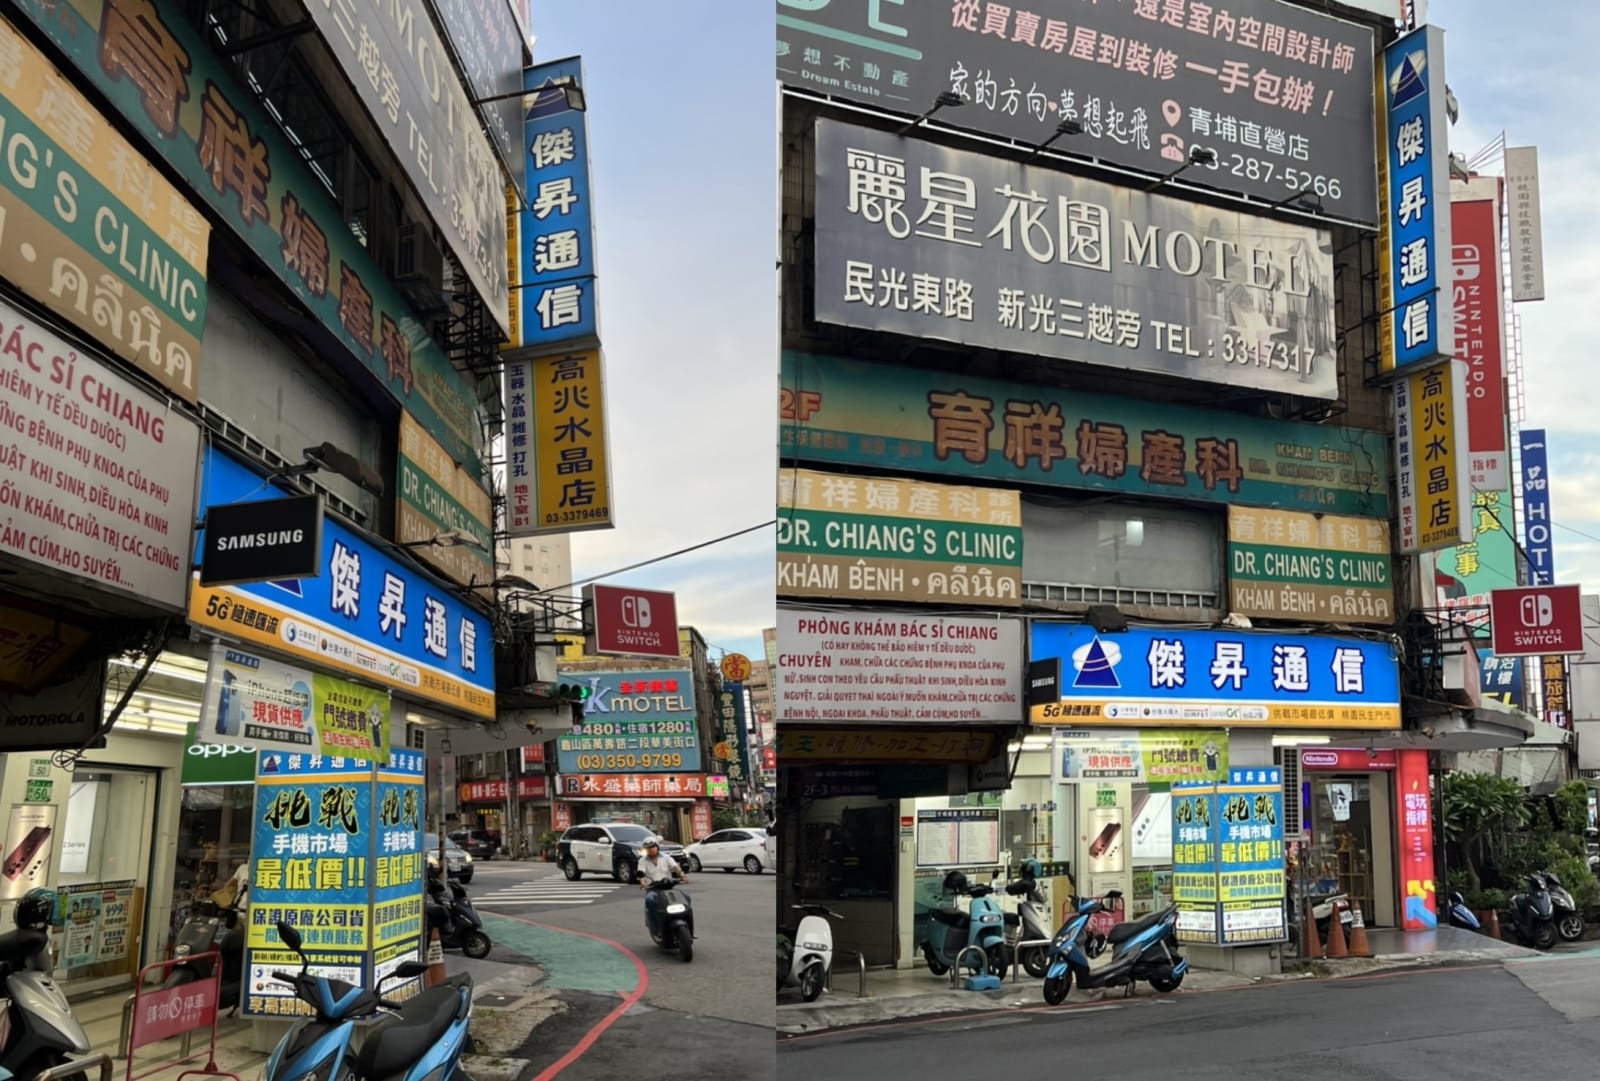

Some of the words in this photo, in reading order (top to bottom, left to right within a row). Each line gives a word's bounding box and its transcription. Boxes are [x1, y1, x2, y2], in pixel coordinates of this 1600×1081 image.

[801, 69, 840, 88] Dream
[844, 79, 881, 96] Estate
[1188, 106, 1310, 161] 青埔直營店
[531, 127, 582, 330] 傑昇通信
[846, 147, 1112, 273] 麗星花園
[1120, 218, 1311, 298] MOTEL
[1396, 116, 1430, 349] 傑昇通信
[94, 206, 198, 321] CLINIC
[844, 260, 975, 321] 民光東路
[998, 287, 1142, 349] 新光三越旁
[1222, 333, 1316, 375] 3317317
[1469, 285, 1485, 398] NINTENDO
[510, 364, 525, 390] 玉器
[35, 387, 44, 405] Y
[80, 374, 165, 444] CHIANG
[511, 392, 526, 418] 水晶
[550, 355, 597, 509] 高兆水晶店
[928, 388, 1244, 493] 育祥婦產科
[1420, 367, 1451, 529] 高兆水晶店
[28, 418, 64, 452] BỆNH
[67, 438, 91, 468] PHỤ
[127, 468, 147, 494] CỦA
[150, 482, 169, 506] PHỤ
[512, 450, 528, 477] 打孔
[30, 458, 53, 484] KHI
[144, 510, 168, 536] KINH
[515, 517, 529, 527] B1
[546, 507, 608, 524] 03-3379469
[102, 526, 120, 553] TRỊ
[122, 531, 143, 558] CÁC
[217, 529, 304, 551] SAMSUNG
[777, 517, 818, 548] DR.
[825, 520, 937, 555] CHIANG'S
[946, 530, 1017, 561] CLINIC
[1234, 550, 1260, 576] DR.
[1264, 552, 1335, 580] CHIANG'S
[1340, 558, 1386, 584] CLINIC
[206, 595, 228, 620] 5G
[331, 541, 476, 672] 傑昇通信
[617, 629, 660, 637] NINTENDO
[617, 635, 661, 646] SWITCH
[854, 618, 897, 637] KHÁM
[900, 618, 928, 638] BÁC
[947, 624, 998, 641] CHIANG
[1514, 629, 1562, 637] NINTENDO
[1514, 635, 1563, 647] SWITCH
[778, 651, 832, 668] CHUYÊN
[836, 641, 850, 651] HAY
[1148, 639, 1364, 692] 傑昇通信
[818, 674, 834, 685] CON
[835, 674, 854, 685] THEO
[1031, 676, 1055, 688] SAMSUNG
[5, 712, 85, 727] MOTOROLA
[252, 700, 305, 729] 現貨供應
[577, 753, 682, 770] (03)350-9799
[583, 776, 703, 793] 永盛藥師藥局
[272, 833, 348, 855] 手機市場
